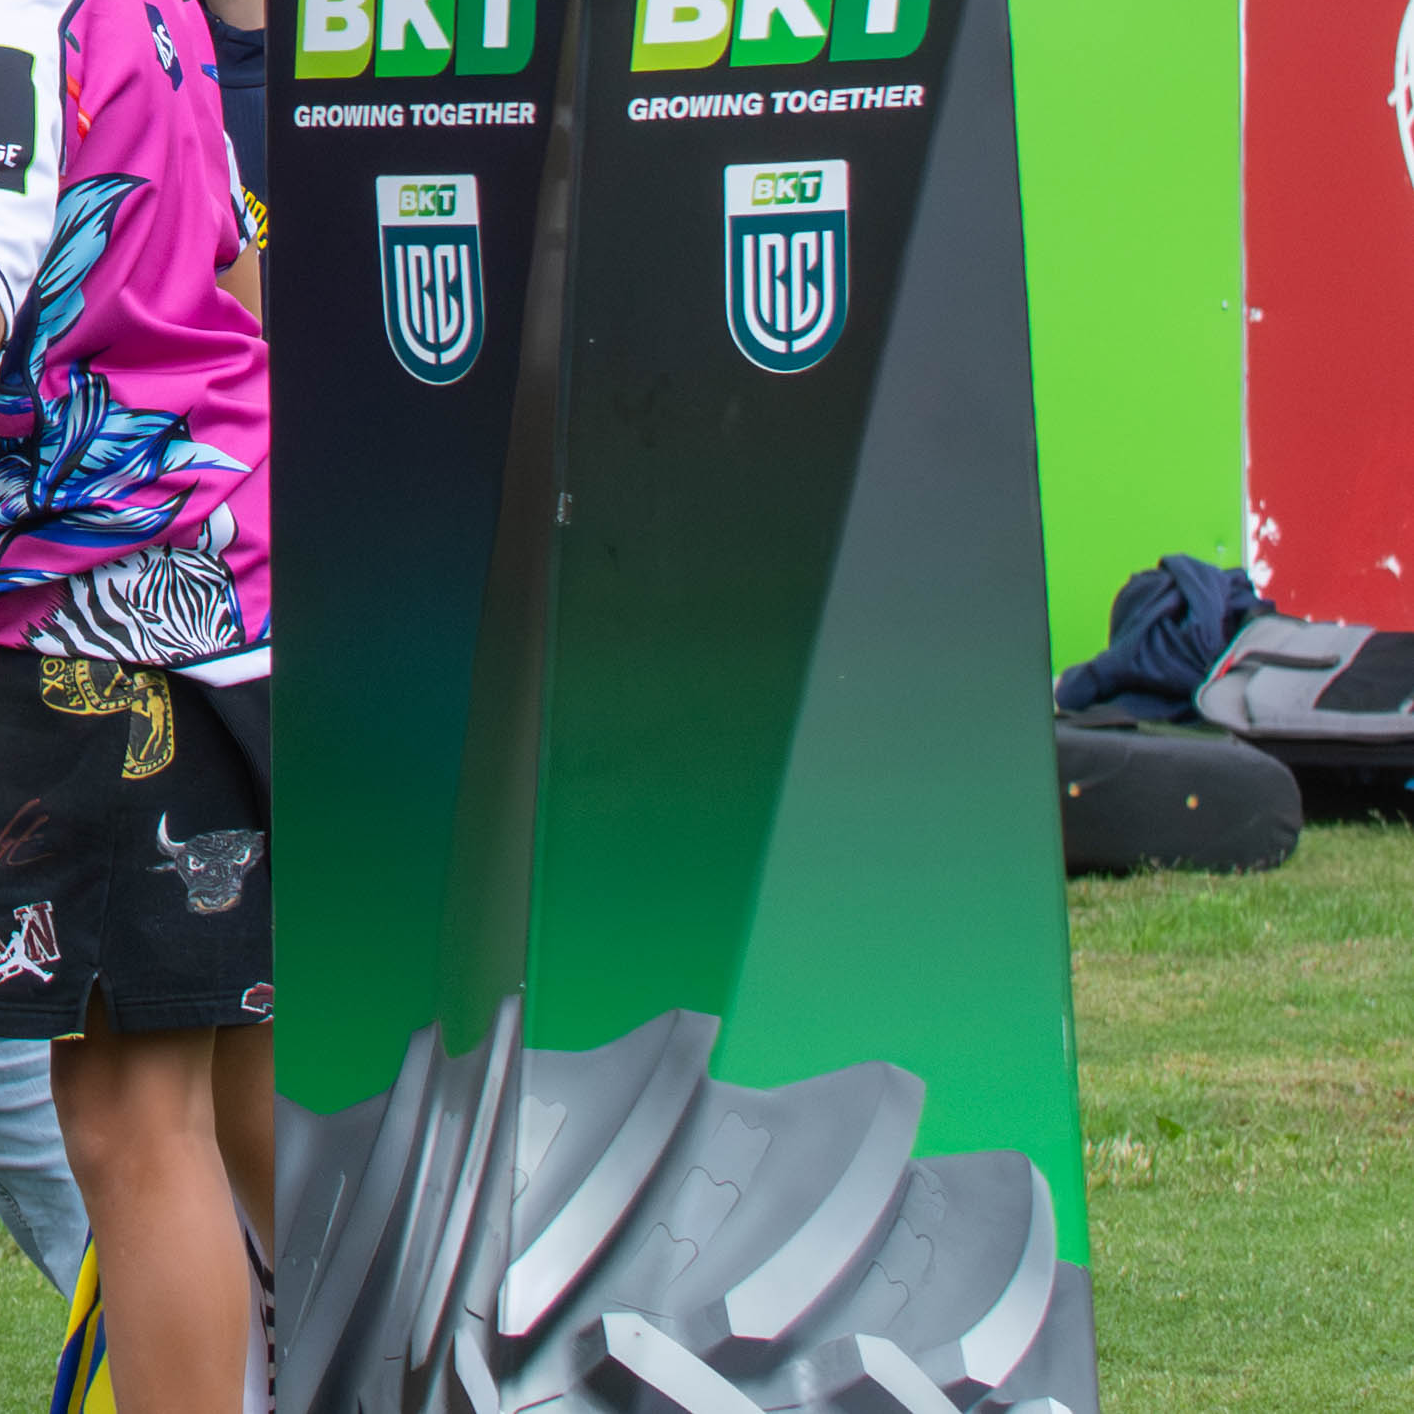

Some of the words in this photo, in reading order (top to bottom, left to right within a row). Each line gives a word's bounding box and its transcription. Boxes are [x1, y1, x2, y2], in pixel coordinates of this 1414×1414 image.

[293, 104, 405, 129] GROWING
[409, 101, 537, 127] TOGETHER
[627, 91, 764, 122] GROWING
[771, 84, 926, 115] TOGETHER
[398, 187, 457, 215] BKT
[752, 170, 823, 203] BKT
